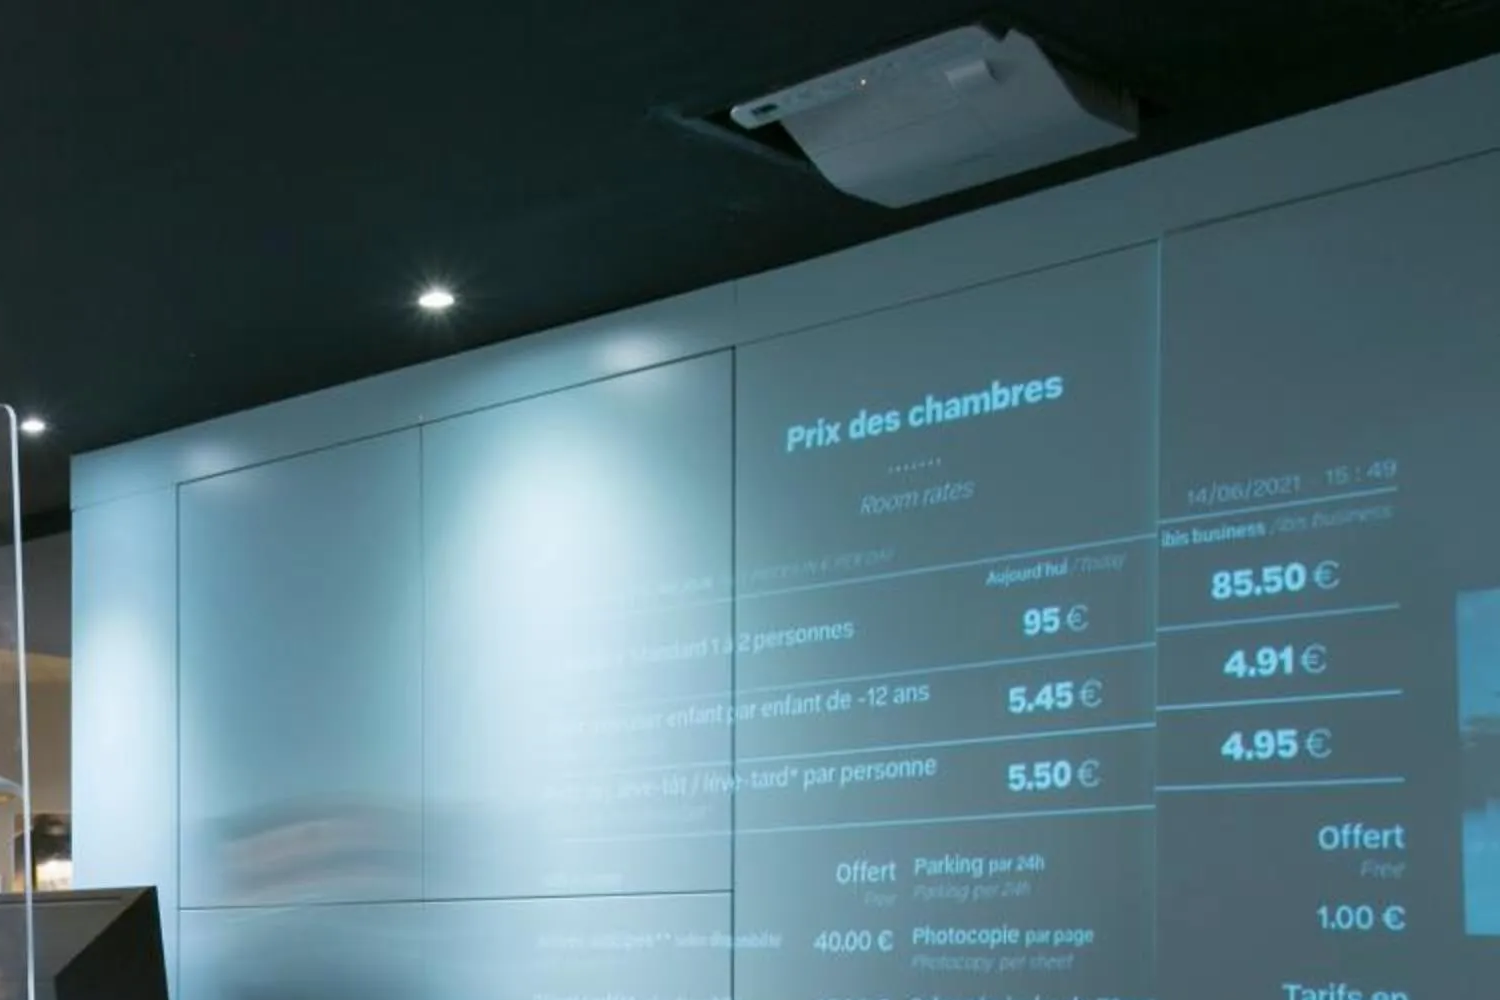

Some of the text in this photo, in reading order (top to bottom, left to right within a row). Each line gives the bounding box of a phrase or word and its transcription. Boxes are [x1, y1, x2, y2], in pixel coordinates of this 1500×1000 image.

[785, 374, 1063, 453] Prix des chambres
[1192, 521, 1267, 545] business
[1210, 559, 1342, 601] 85.50 €
[1021, 603, 1090, 638] 95 €
[753, 620, 855, 658] personnes
[1222, 642, 1328, 679] 4.91 €
[761, 691, 823, 717] enfant
[825, 687, 852, 710] de
[857, 687, 889, 706] -12
[893, 683, 931, 705] ans
[1007, 676, 1104, 714] 5.45 €
[1220, 726, 1334, 762] 4.95 €
[803, 764, 837, 792] par
[840, 756, 938, 789] personne
[1007, 757, 1102, 793] 5.50 €
[1317, 823, 1406, 852] Offert
[835, 853, 1046, 886] Offert Parking par 24h
[1316, 904, 1407, 932] 1.00 €
[812, 929, 872, 953] 40.00
[877, 929, 894, 952] €
[912, 924, 1020, 951] Photocopie
[1053, 927, 1095, 948] page
